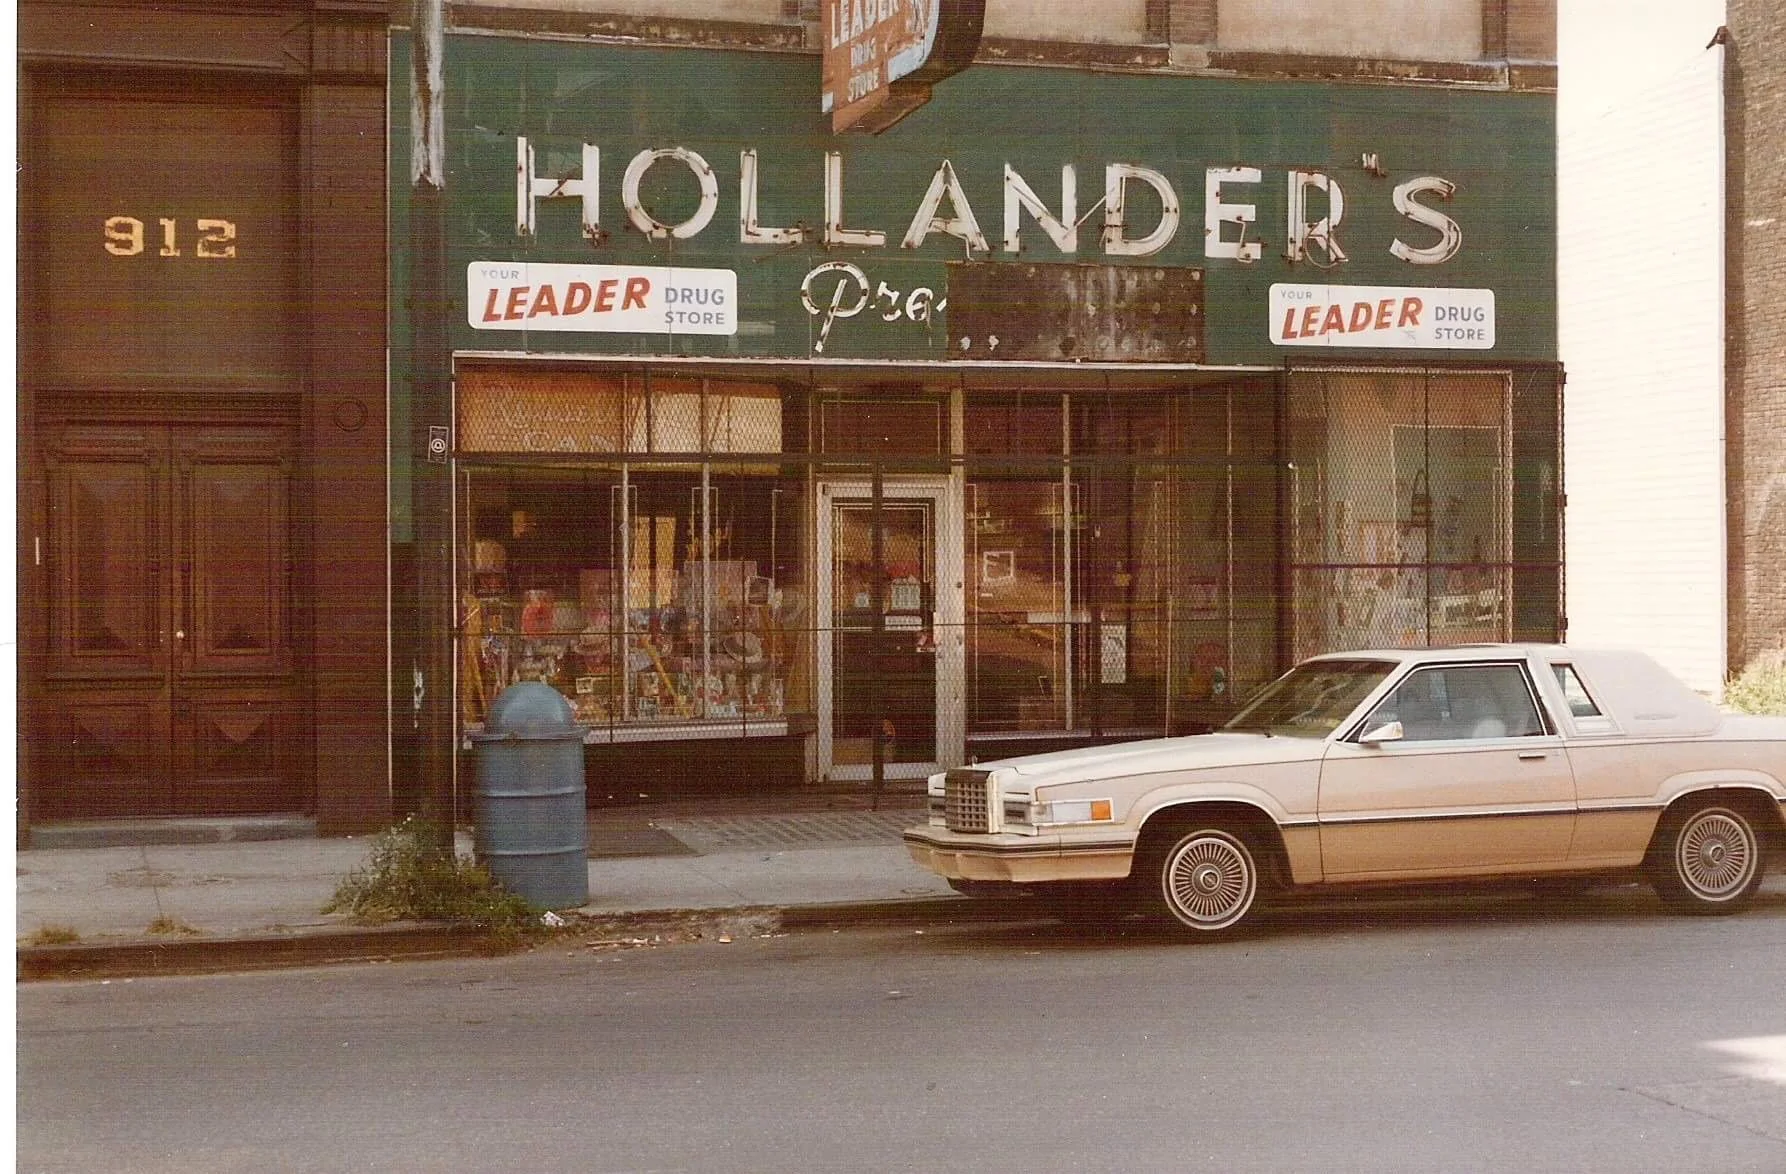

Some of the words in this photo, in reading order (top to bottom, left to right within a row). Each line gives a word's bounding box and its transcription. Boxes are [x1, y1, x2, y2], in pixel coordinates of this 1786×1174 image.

[850, 37, 877, 69] DRUG
[848, 67, 880, 103] STORE
[104, 216, 237, 257] 912
[481, 269, 520, 280] YOUR
[482, 277, 651, 323] LEADER
[665, 287, 725, 306] DRUG
[1280, 290, 1313, 300] YOUR
[664, 311, 725, 325] STORE
[1281, 297, 1424, 340] LEADER
[1435, 306, 1485, 322] DRUG
[1435, 327, 1484, 341] STORE
